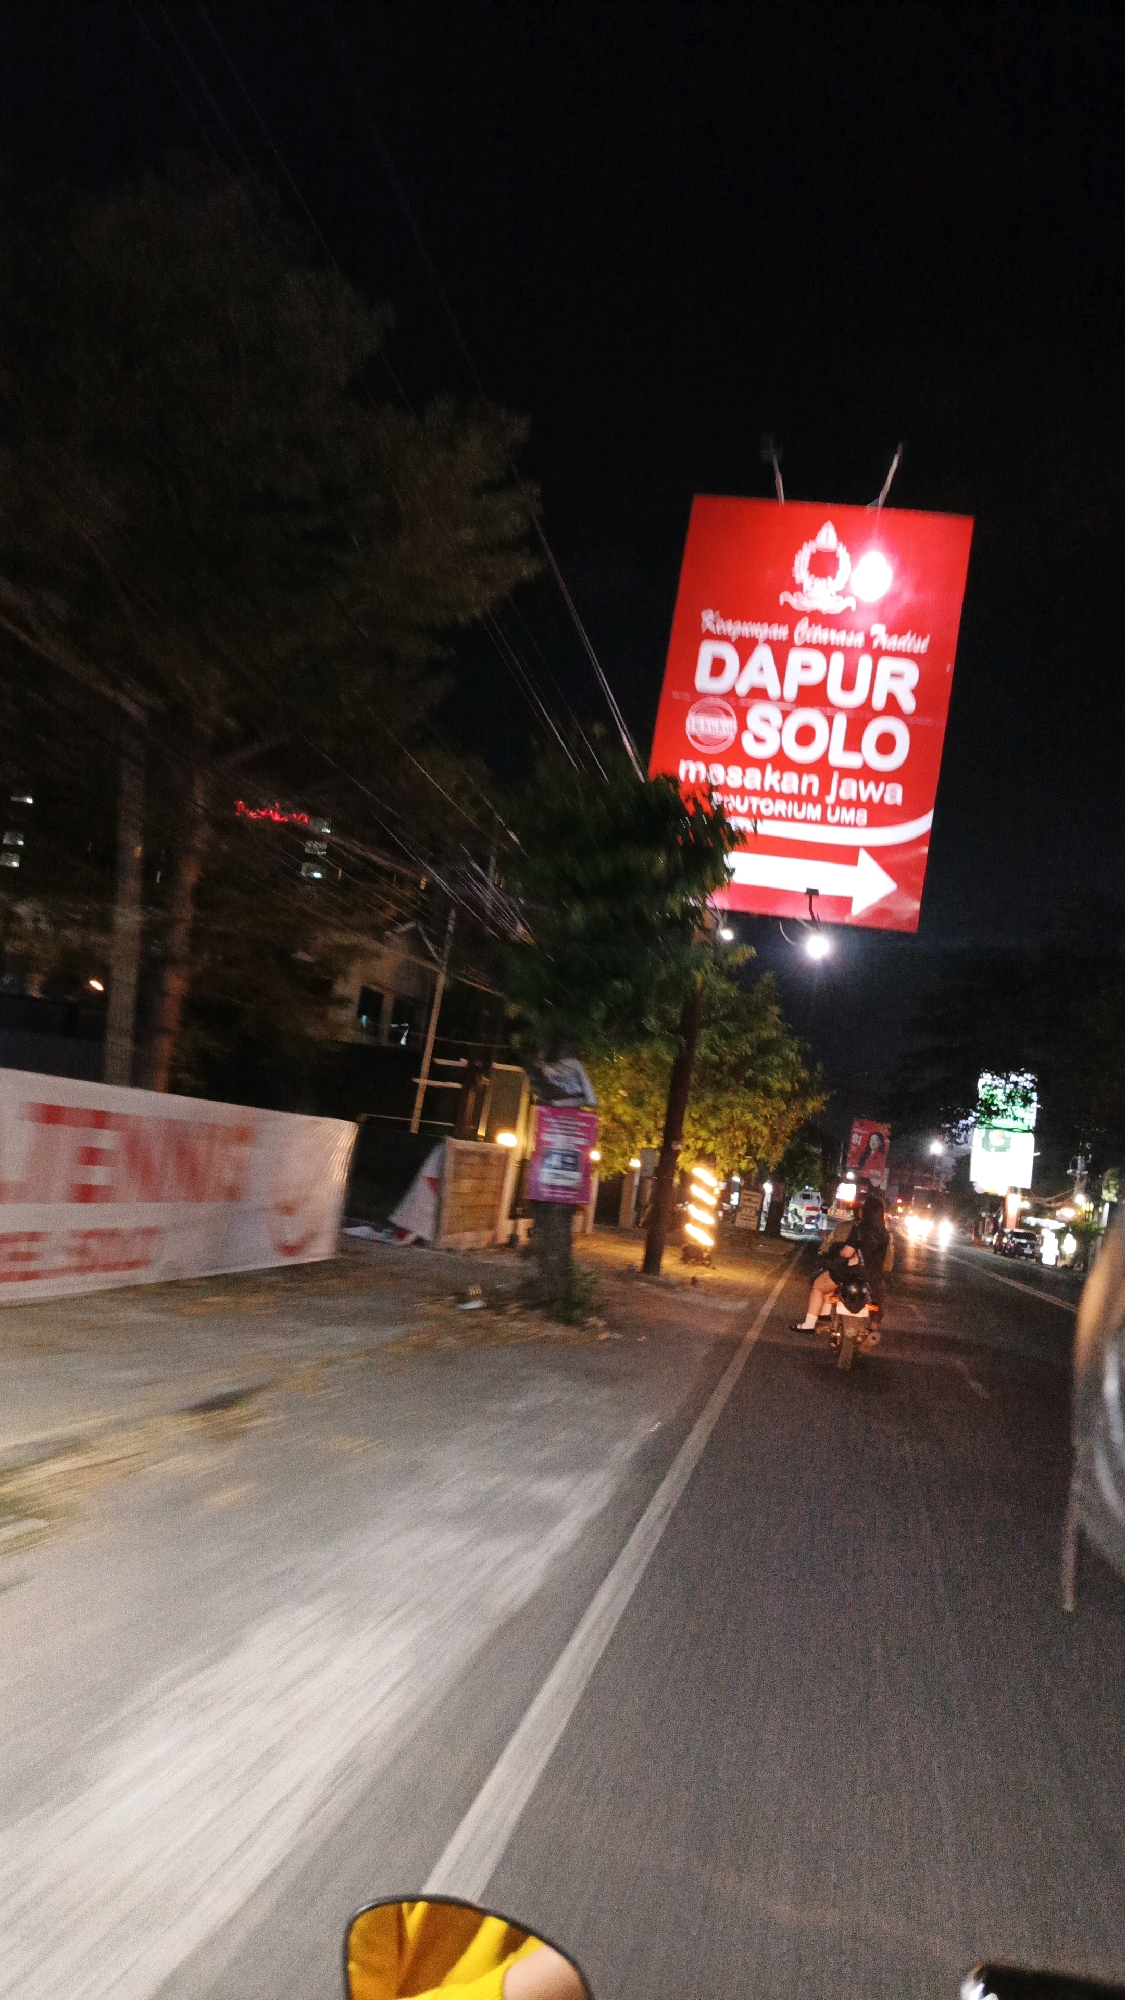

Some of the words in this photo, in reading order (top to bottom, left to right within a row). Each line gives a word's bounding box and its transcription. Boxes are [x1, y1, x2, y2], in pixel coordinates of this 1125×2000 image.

[694, 639, 920, 713] DAPUR
[740, 702, 911, 773] SOLO
[678, 758, 820, 797] masakan
[825, 769, 904, 806] jawa
